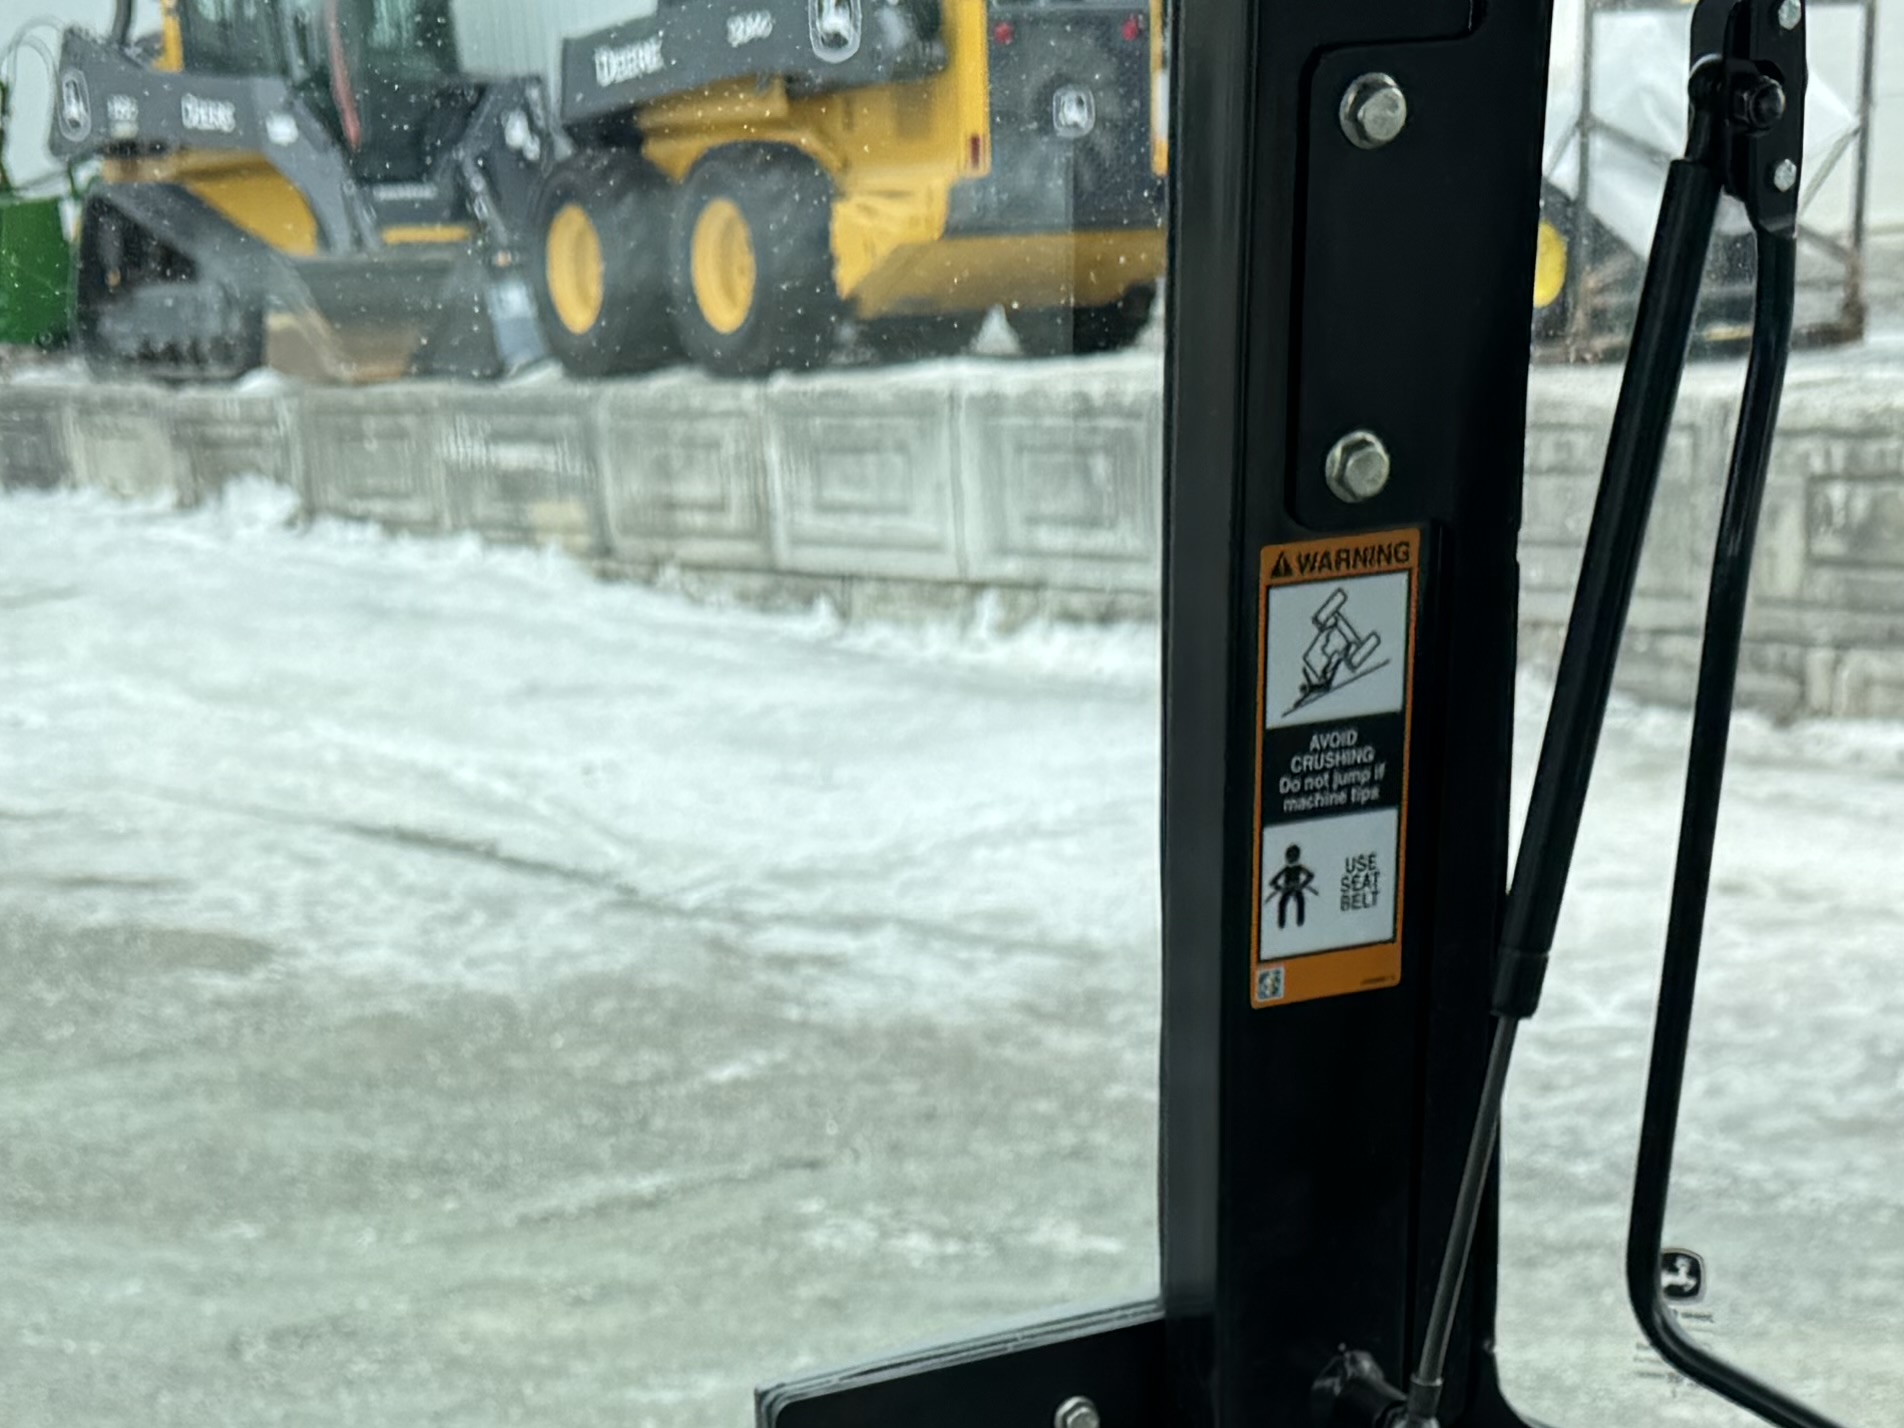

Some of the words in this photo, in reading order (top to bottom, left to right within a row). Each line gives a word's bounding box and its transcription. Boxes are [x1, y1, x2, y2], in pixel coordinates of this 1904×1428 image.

[1296, 541, 1411, 577] WARNING
[1309, 729, 1359, 752] AVOID
[1290, 745, 1376, 774] CRUSHING
[1279, 776, 1302, 795] Do
[1304, 773, 1330, 792] not
[1332, 766, 1372, 791] jump
[1374, 761, 1387, 782] if
[1283, 789, 1348, 814] machine
[1350, 785, 1381, 806] tips
[1344, 851, 1378, 874] USE
[1340, 870, 1381, 893] SEAT
[1340, 890, 1381, 912] BELT
